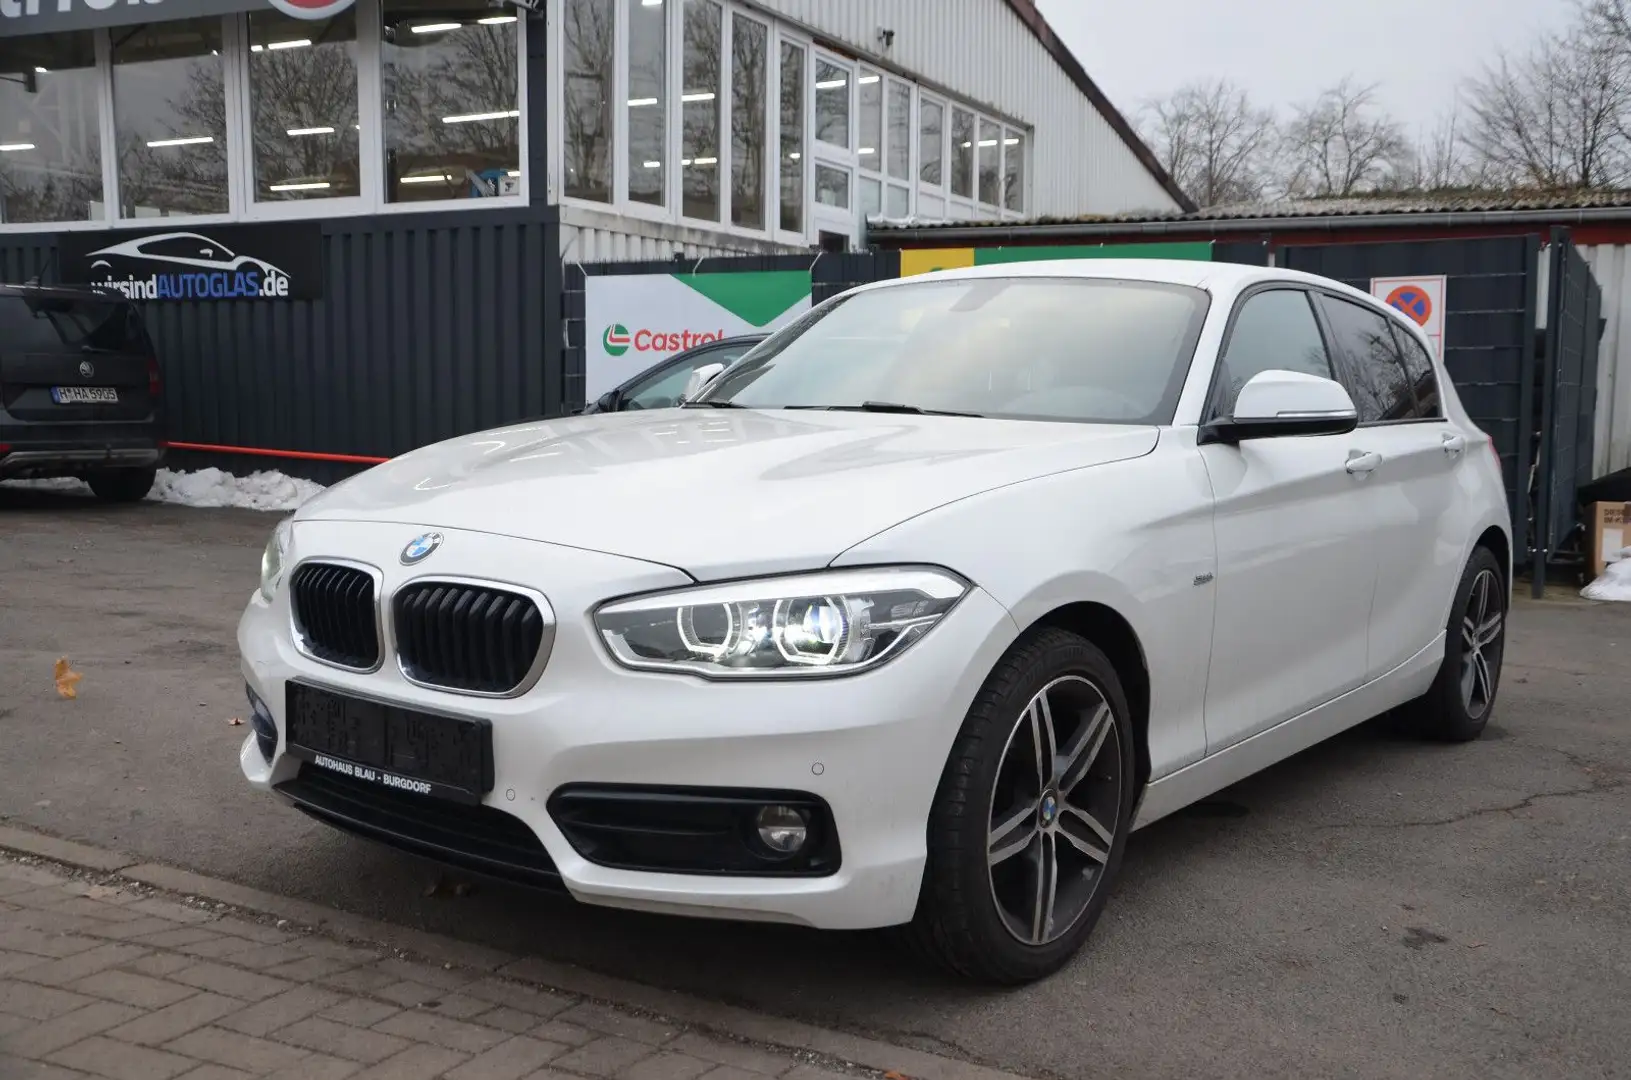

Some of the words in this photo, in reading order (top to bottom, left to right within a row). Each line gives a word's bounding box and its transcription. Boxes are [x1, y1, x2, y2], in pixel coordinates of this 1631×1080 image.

[315, 755, 353, 775] AUTOHAUS
[354, 766, 376, 781] BLAU
[383, 774, 432, 794] BURGDORF
